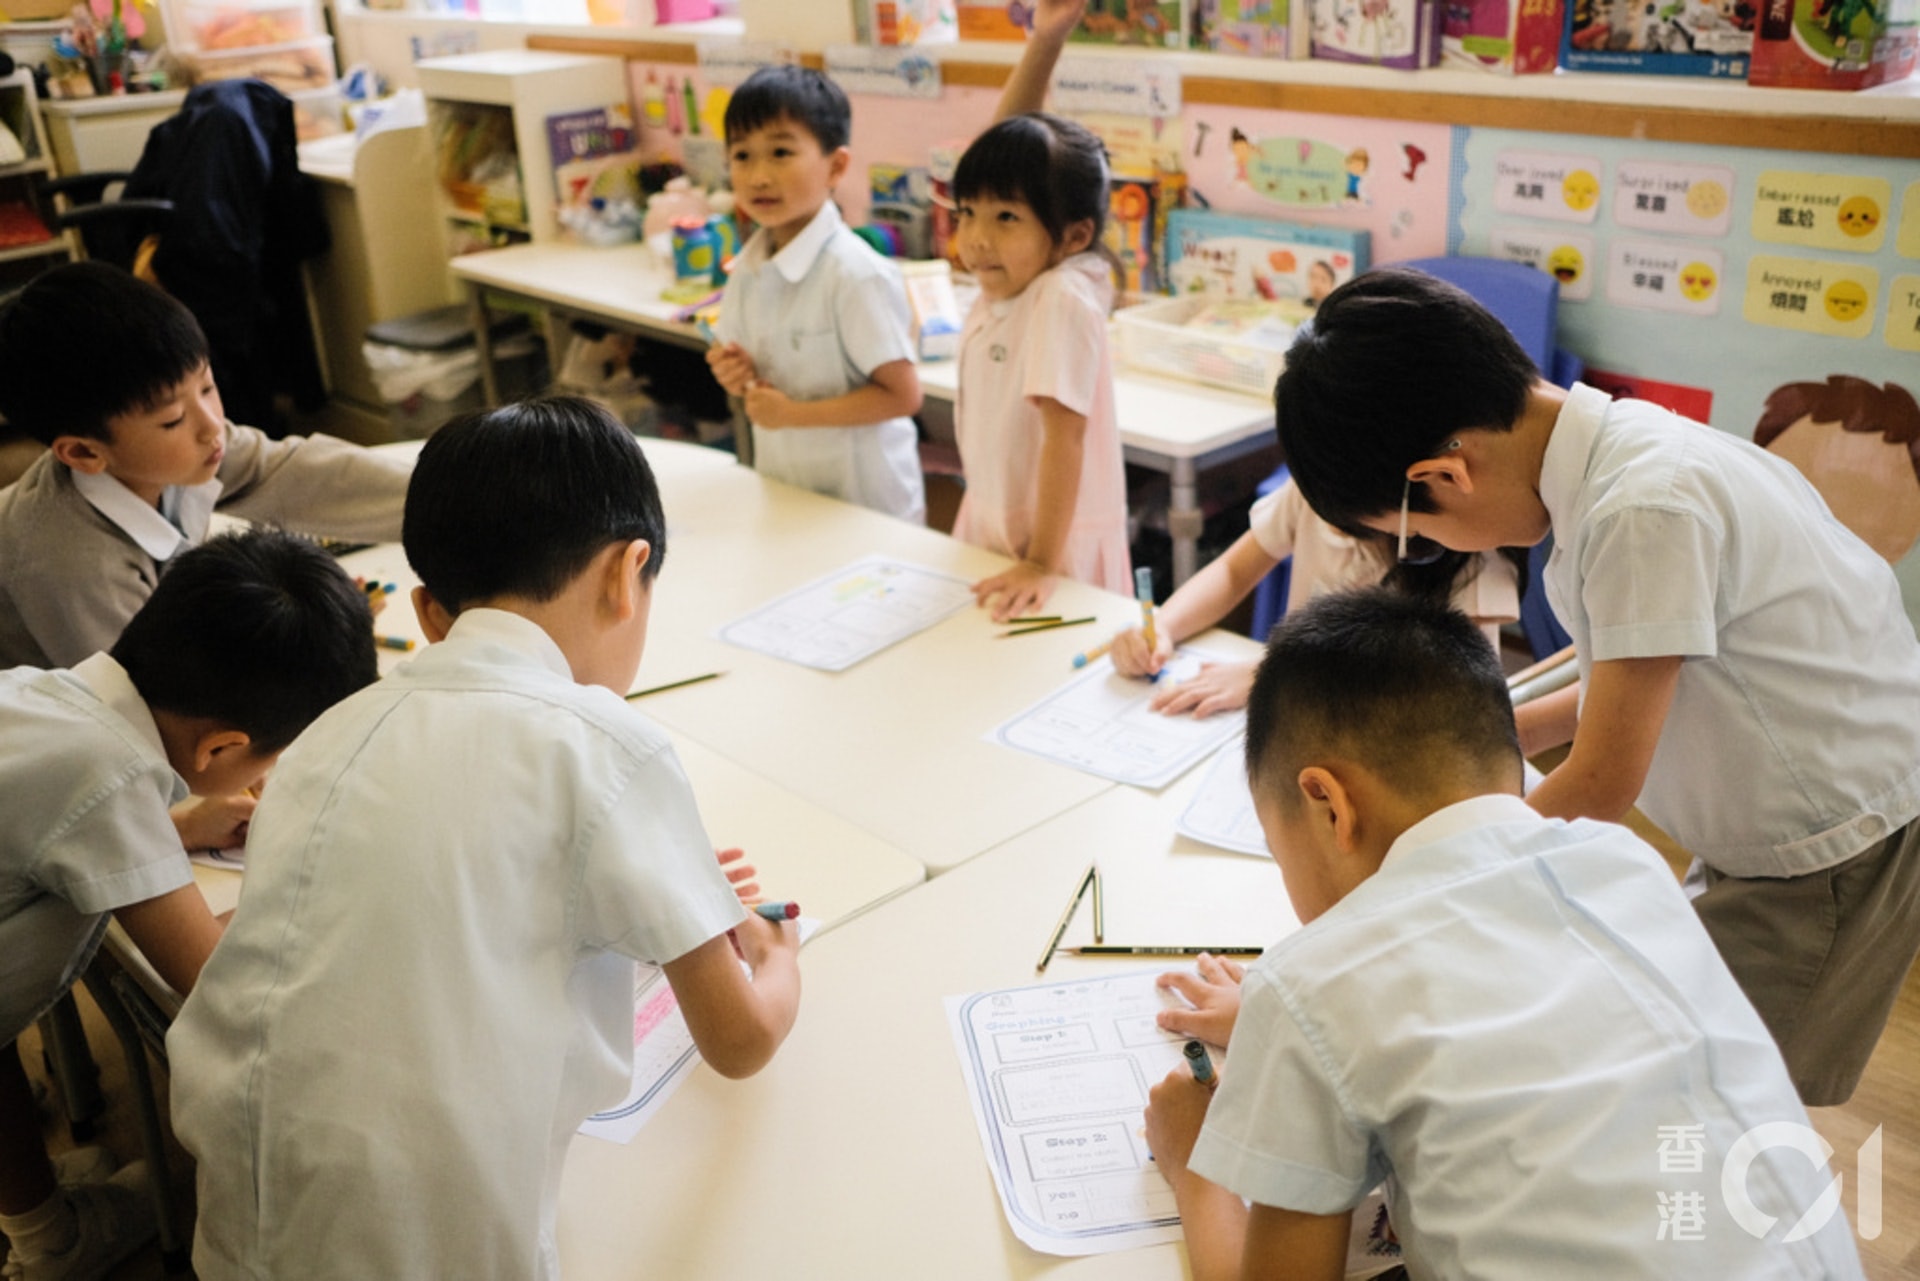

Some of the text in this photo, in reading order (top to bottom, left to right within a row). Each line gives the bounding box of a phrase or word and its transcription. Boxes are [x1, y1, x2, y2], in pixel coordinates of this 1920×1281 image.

[1758, 187, 1841, 206] Embarrassed
[1623, 253, 1678, 271] Blessed
[1633, 272, 1664, 291] 幸福
[1761, 270, 1822, 291] Annoyed
[1020, 1031, 1054, 1044] Step
[1045, 1133, 1107, 1148] Step 2:
[1048, 1191, 1077, 1202] yes
[1057, 1211, 1079, 1221] no
